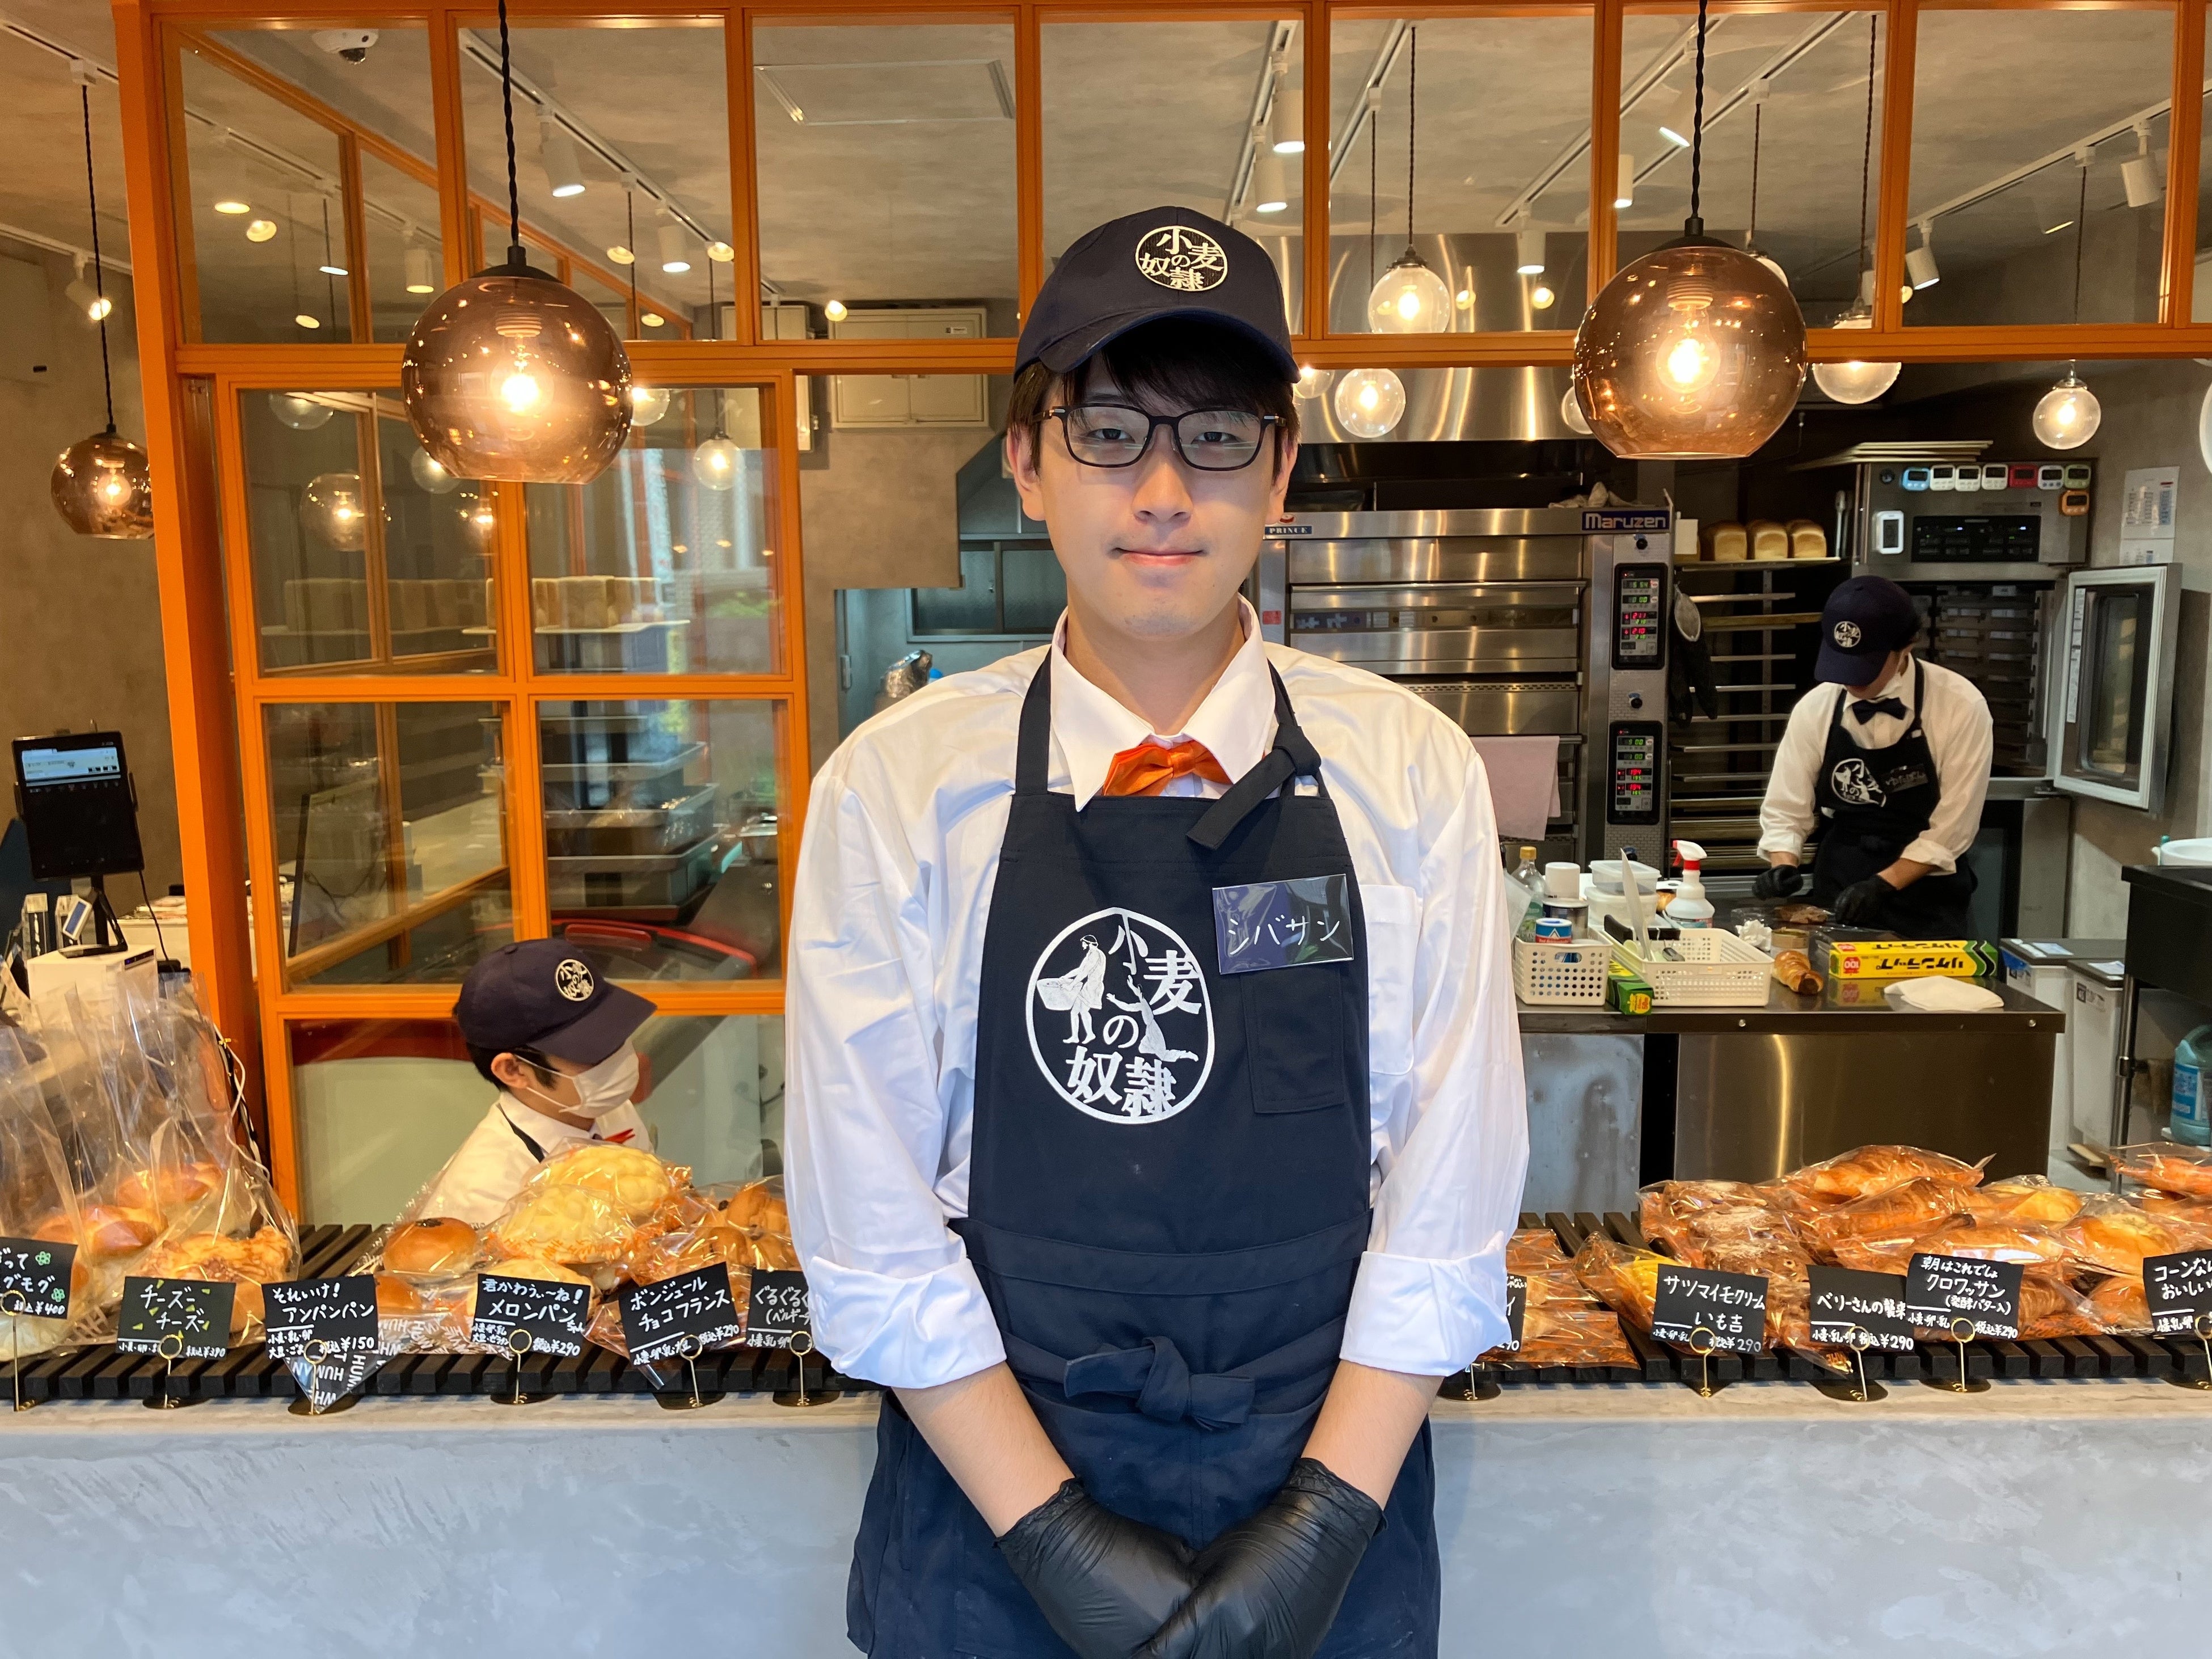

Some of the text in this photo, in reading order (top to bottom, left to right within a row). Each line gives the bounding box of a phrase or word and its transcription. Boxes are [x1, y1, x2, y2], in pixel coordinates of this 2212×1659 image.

[1585, 513, 1666, 529] Maruzen
[1228, 914, 1340, 955] シバサン
[1876, 957, 1964, 970] リケンラップ
[0, 1247, 29, 1270] って
[1920, 1255, 1998, 1278] 朝はこれでしょ
[630, 1277, 708, 1311] ボンジュール
[1664, 1275, 1766, 1310] サツマイモクリーム
[1927, 1274, 2006, 1298] クロワッサン
[282, 1301, 374, 1323] アンパンパン
[488, 1299, 577, 1323] メロンパン
[638, 1289, 731, 1332] チョコフランス
[1817, 1292, 1906, 1320] ベリーさんの襲来
[1695, 1312, 1743, 1333] いも吉
